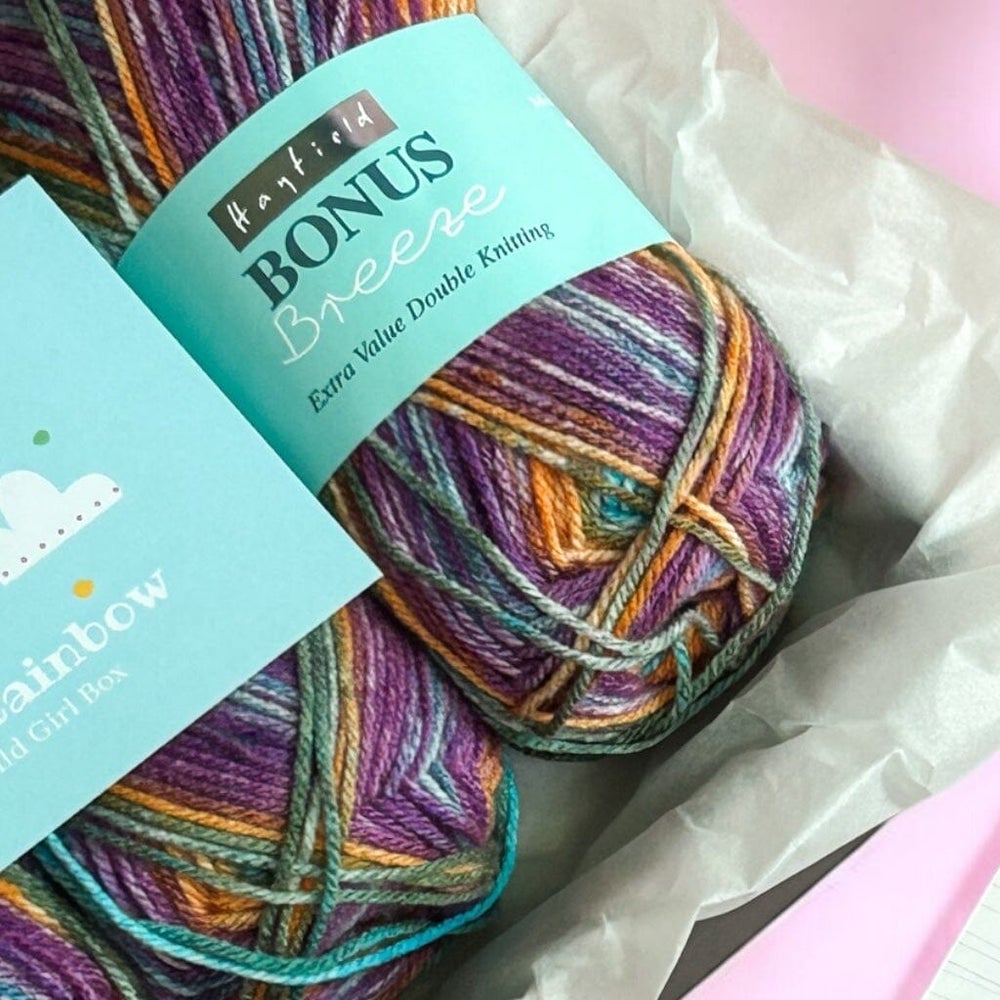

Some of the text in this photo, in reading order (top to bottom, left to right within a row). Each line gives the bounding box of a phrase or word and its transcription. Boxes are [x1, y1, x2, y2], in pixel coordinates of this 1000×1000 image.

[227, 102, 376, 233] Hayfield
[240, 130, 456, 309] BONUS
[272, 184, 506, 366] Breeze
[306, 219, 556, 414] Extra Value Double Knitting
[28, 697, 80, 744] Girl
[77, 667, 129, 706] Box
